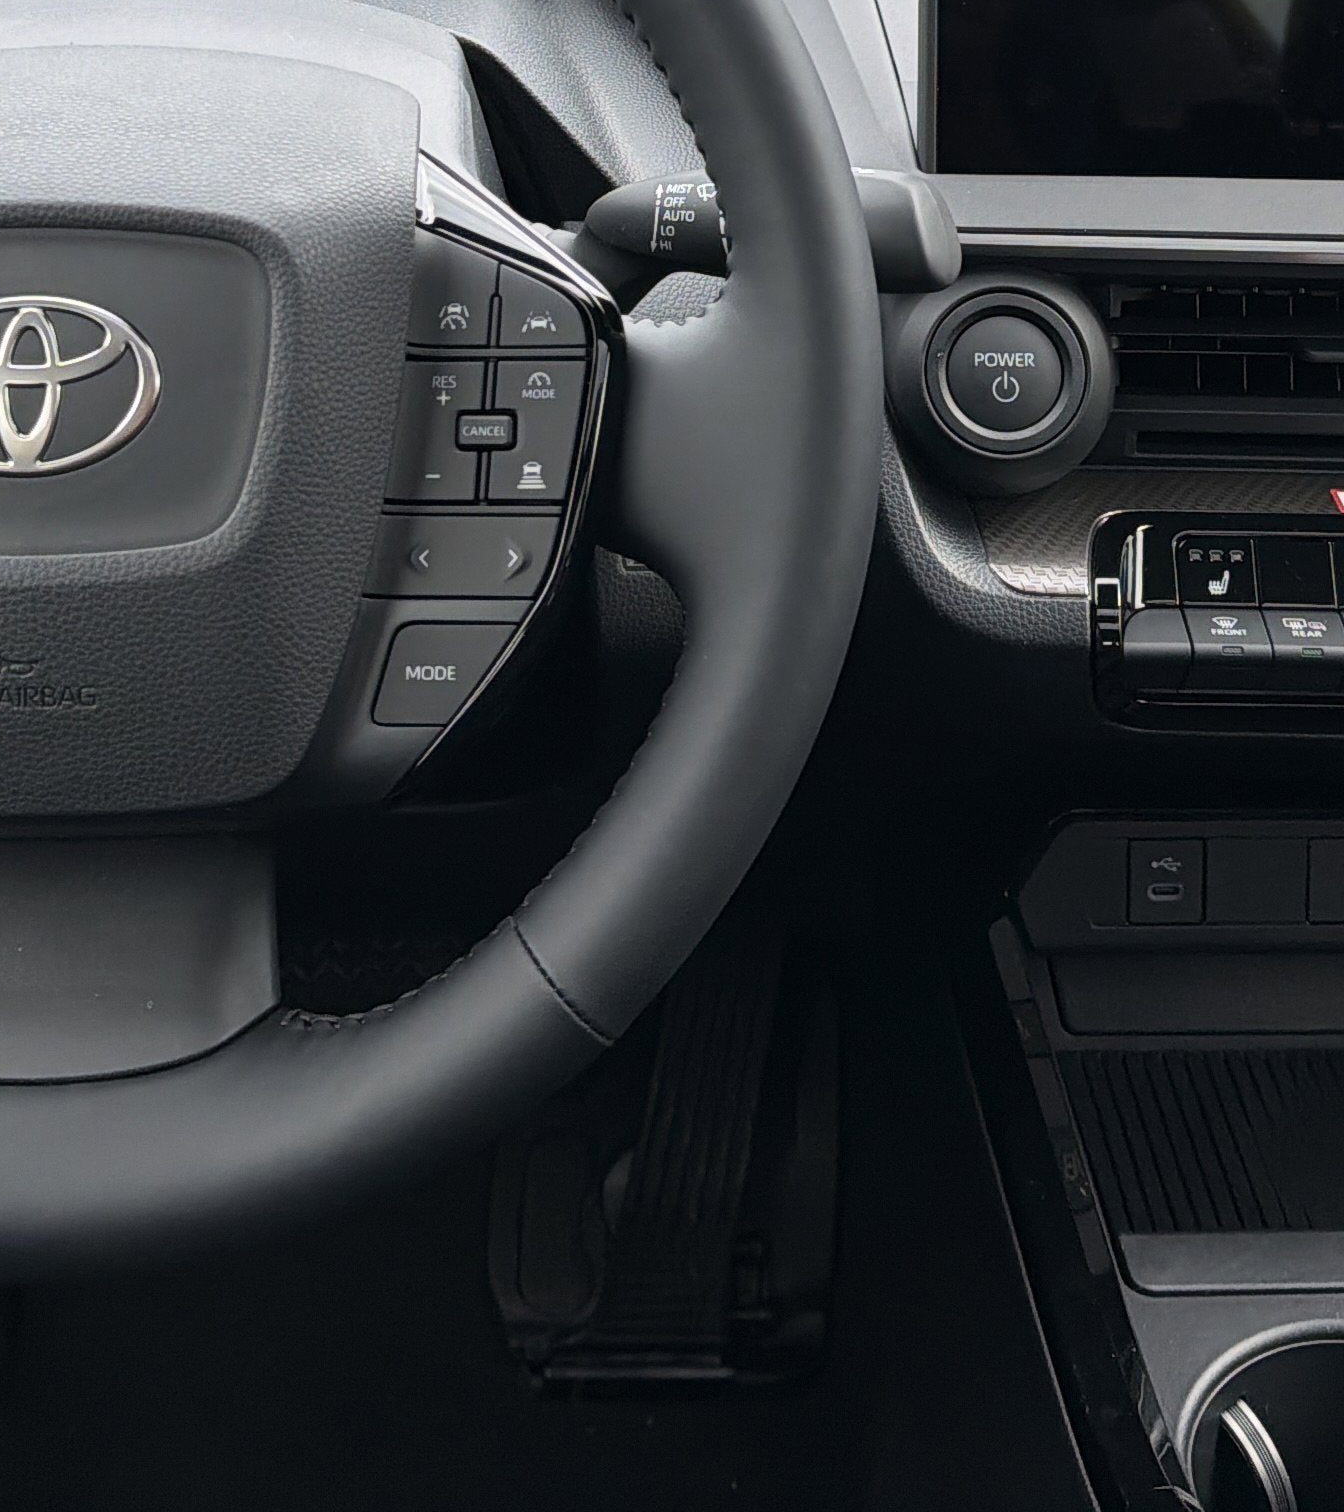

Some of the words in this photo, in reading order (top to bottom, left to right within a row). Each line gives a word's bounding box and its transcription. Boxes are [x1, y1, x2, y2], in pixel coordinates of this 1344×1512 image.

[665, 183, 693, 195] MIST
[663, 196, 687, 208] OFF
[662, 210, 696, 223] AUTO
[660, 225, 676, 237] LO
[659, 240, 673, 252] HI
[974, 352, 1036, 368] POWER
[432, 375, 457, 389] RES
[521, 389, 556, 400] MODE
[462, 425, 506, 438] CANCEL
[1210, 627, 1248, 637] FRONT
[1290, 629, 1324, 638] REAR
[405, 665, 457, 682] MODE
